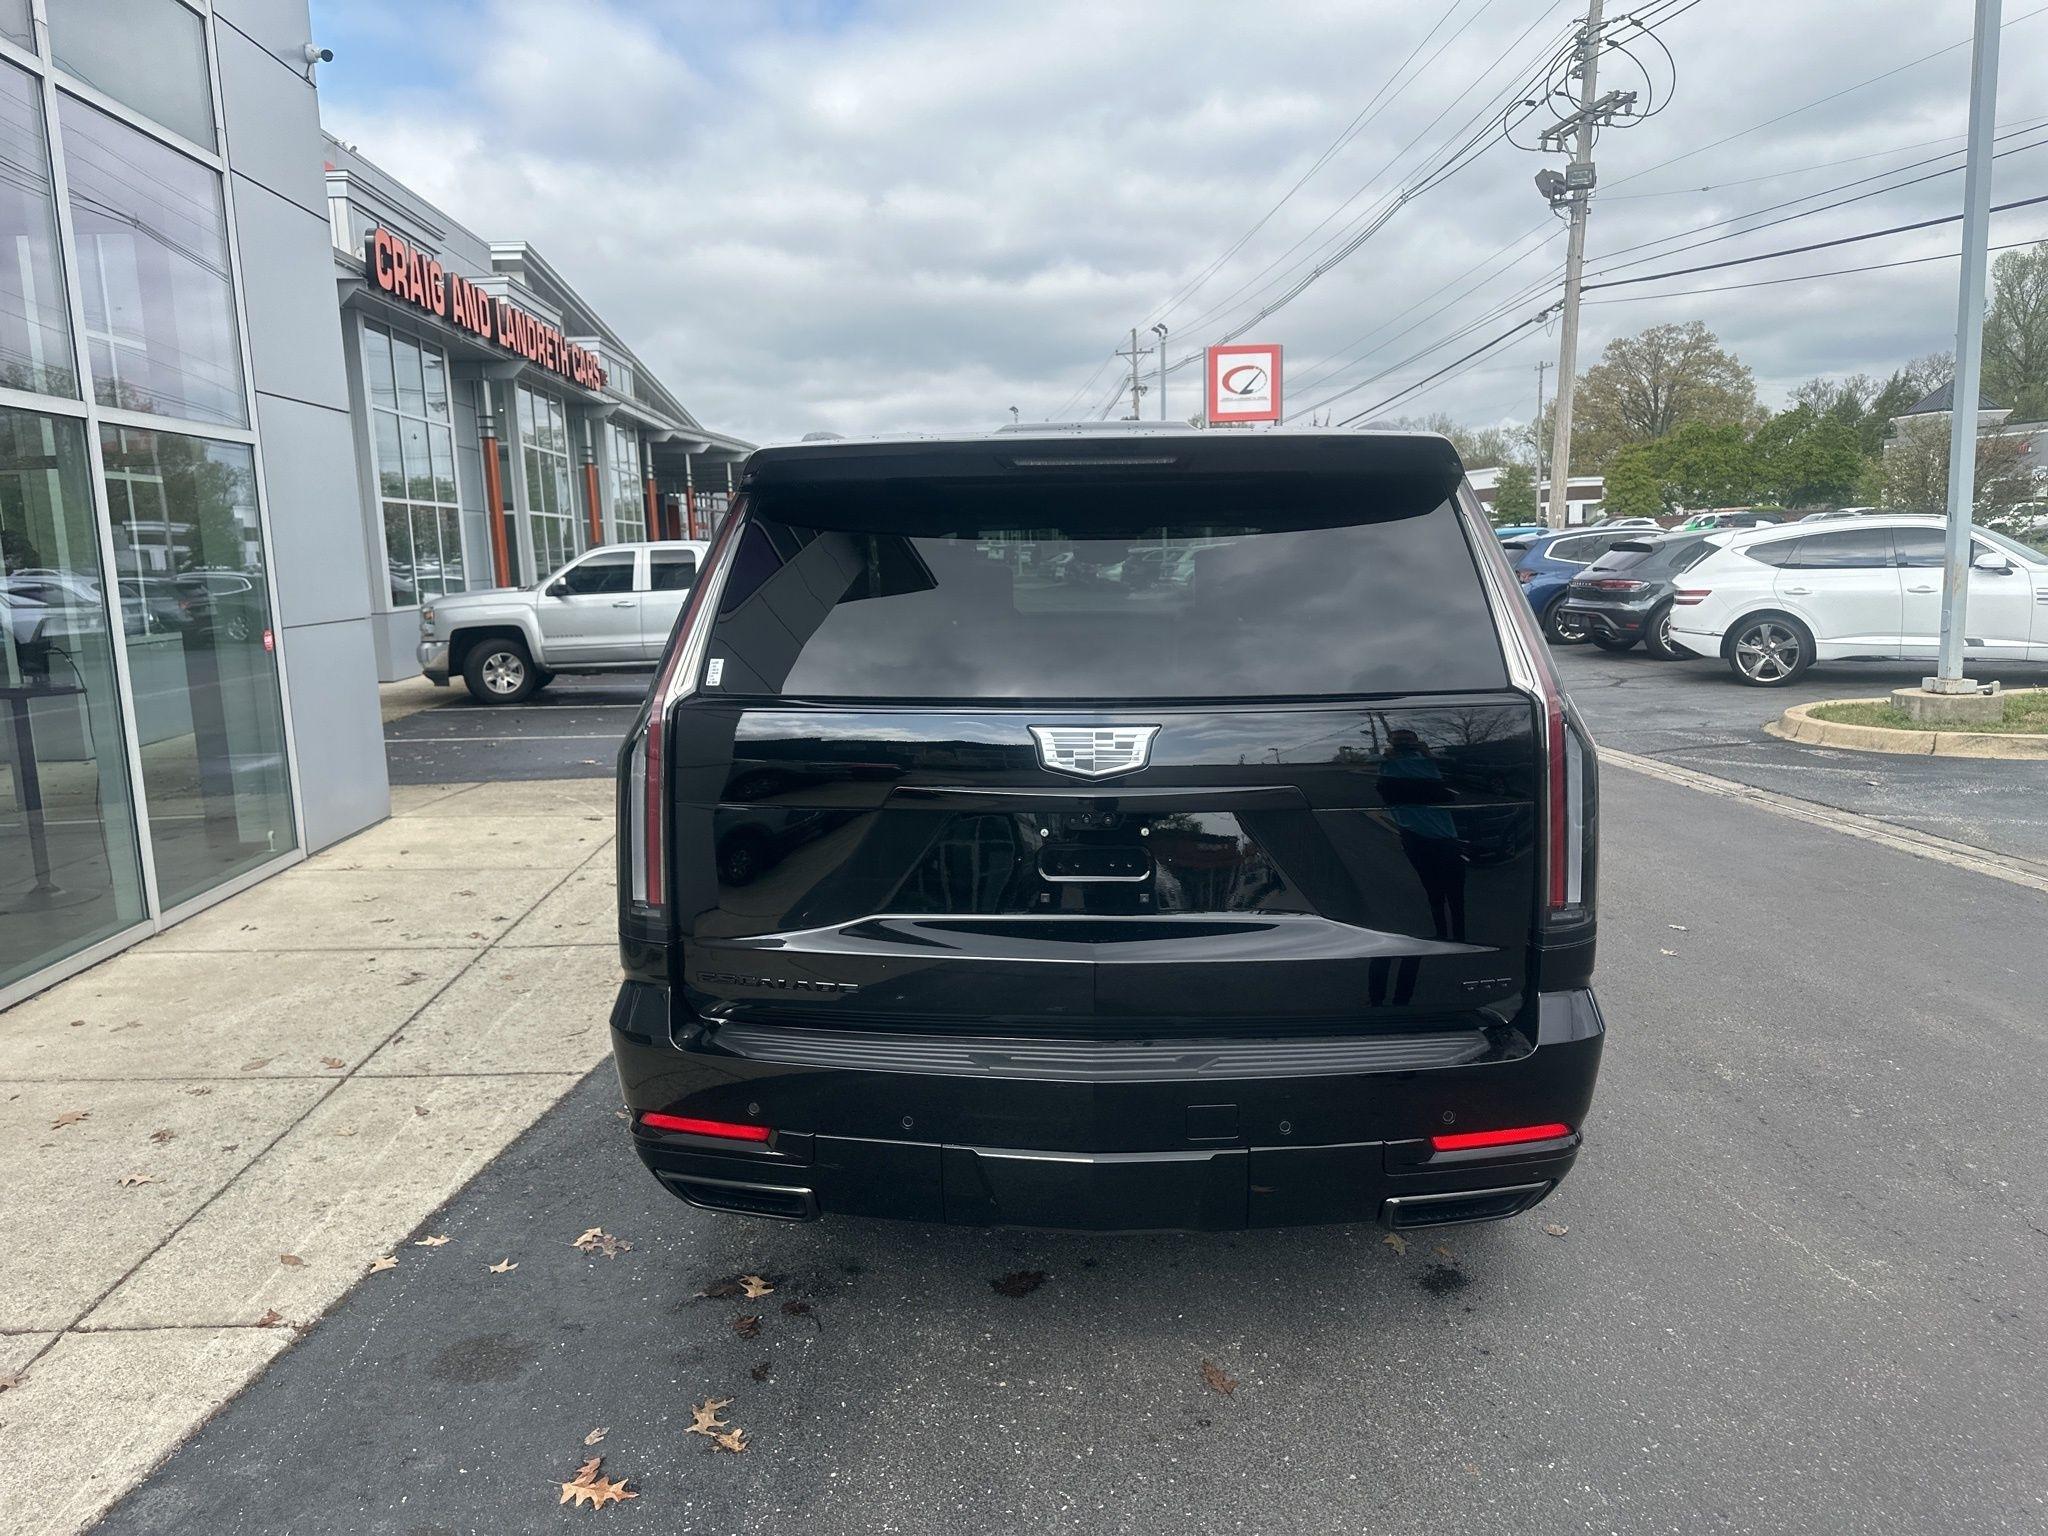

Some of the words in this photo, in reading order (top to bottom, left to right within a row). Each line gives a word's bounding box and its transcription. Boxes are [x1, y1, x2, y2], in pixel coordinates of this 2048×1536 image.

[374, 227, 446, 317] CRAIG
[451, 271, 492, 338] AND
[496, 296, 570, 377] LANDRETH
[571, 342, 601, 392] CARS
